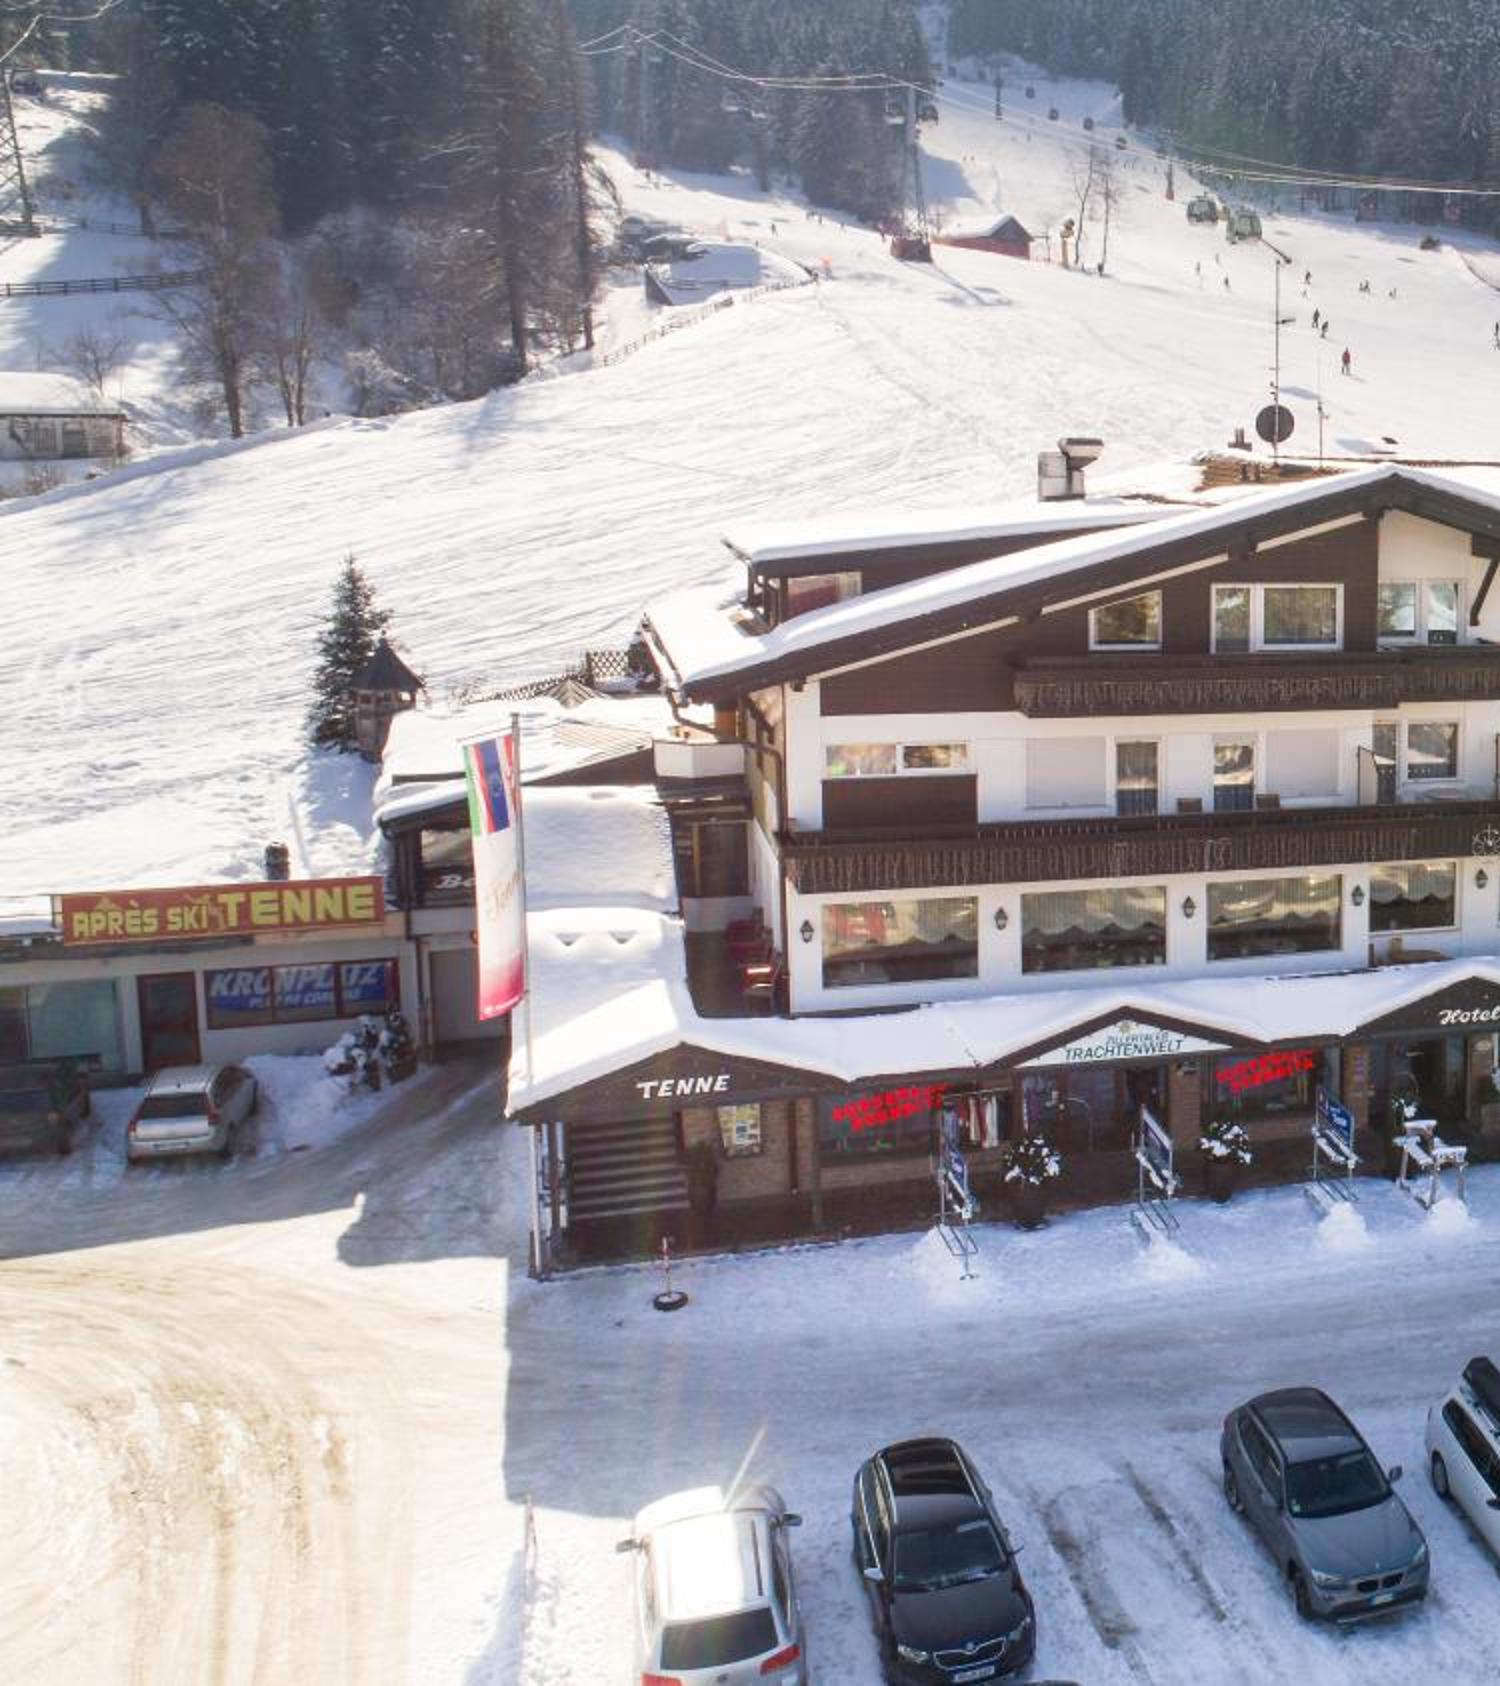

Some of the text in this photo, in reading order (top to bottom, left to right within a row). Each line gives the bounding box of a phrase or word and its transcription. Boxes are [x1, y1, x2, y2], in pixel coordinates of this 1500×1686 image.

[72, 884, 376, 938] APRÈS SKI TENNE
[210, 961, 379, 997] KRONPLTZ
[1065, 1039, 1184, 1060] TRACHTENWELT
[636, 1074, 731, 1099] TENNE
